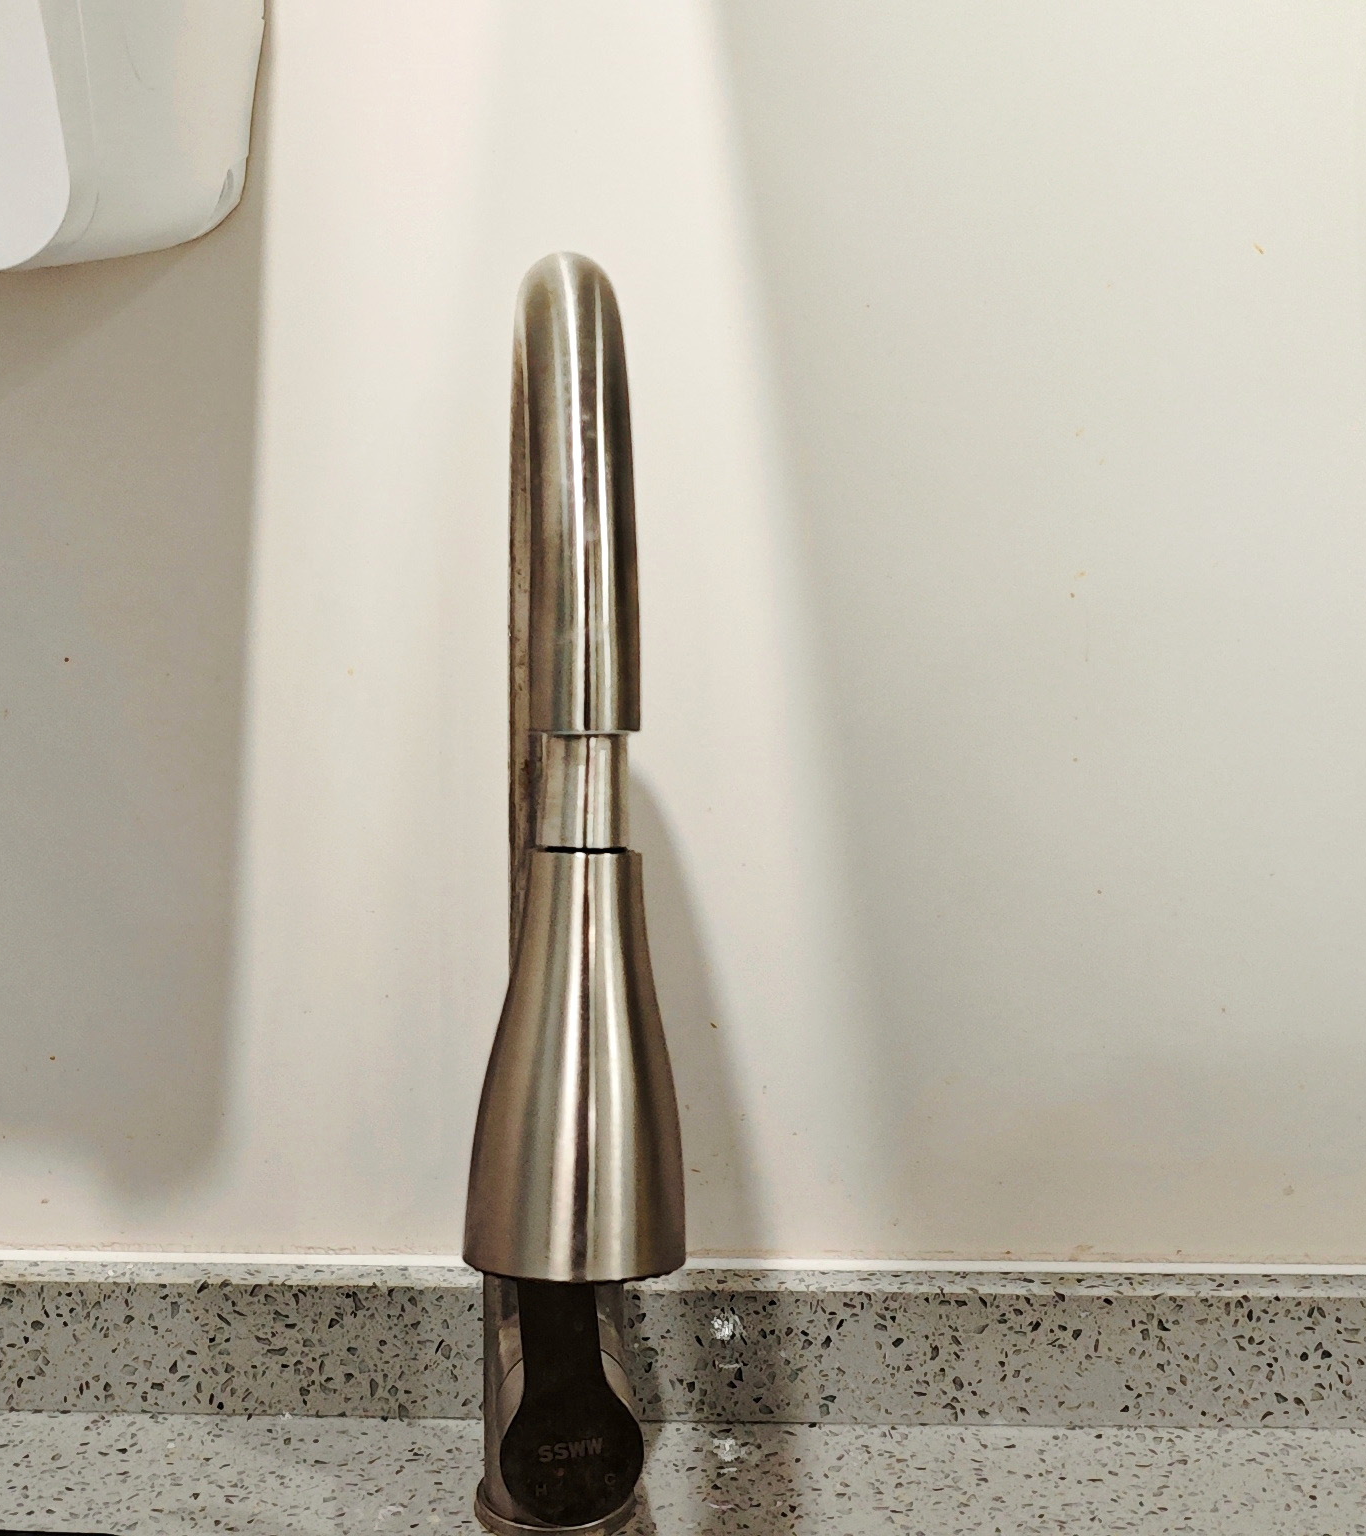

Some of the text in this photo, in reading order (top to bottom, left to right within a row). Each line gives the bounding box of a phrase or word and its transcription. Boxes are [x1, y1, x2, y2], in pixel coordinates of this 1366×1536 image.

[538, 1437, 603, 1462] SSWW
[605, 1473, 616, 1485] C
[536, 1484, 547, 1497] H
